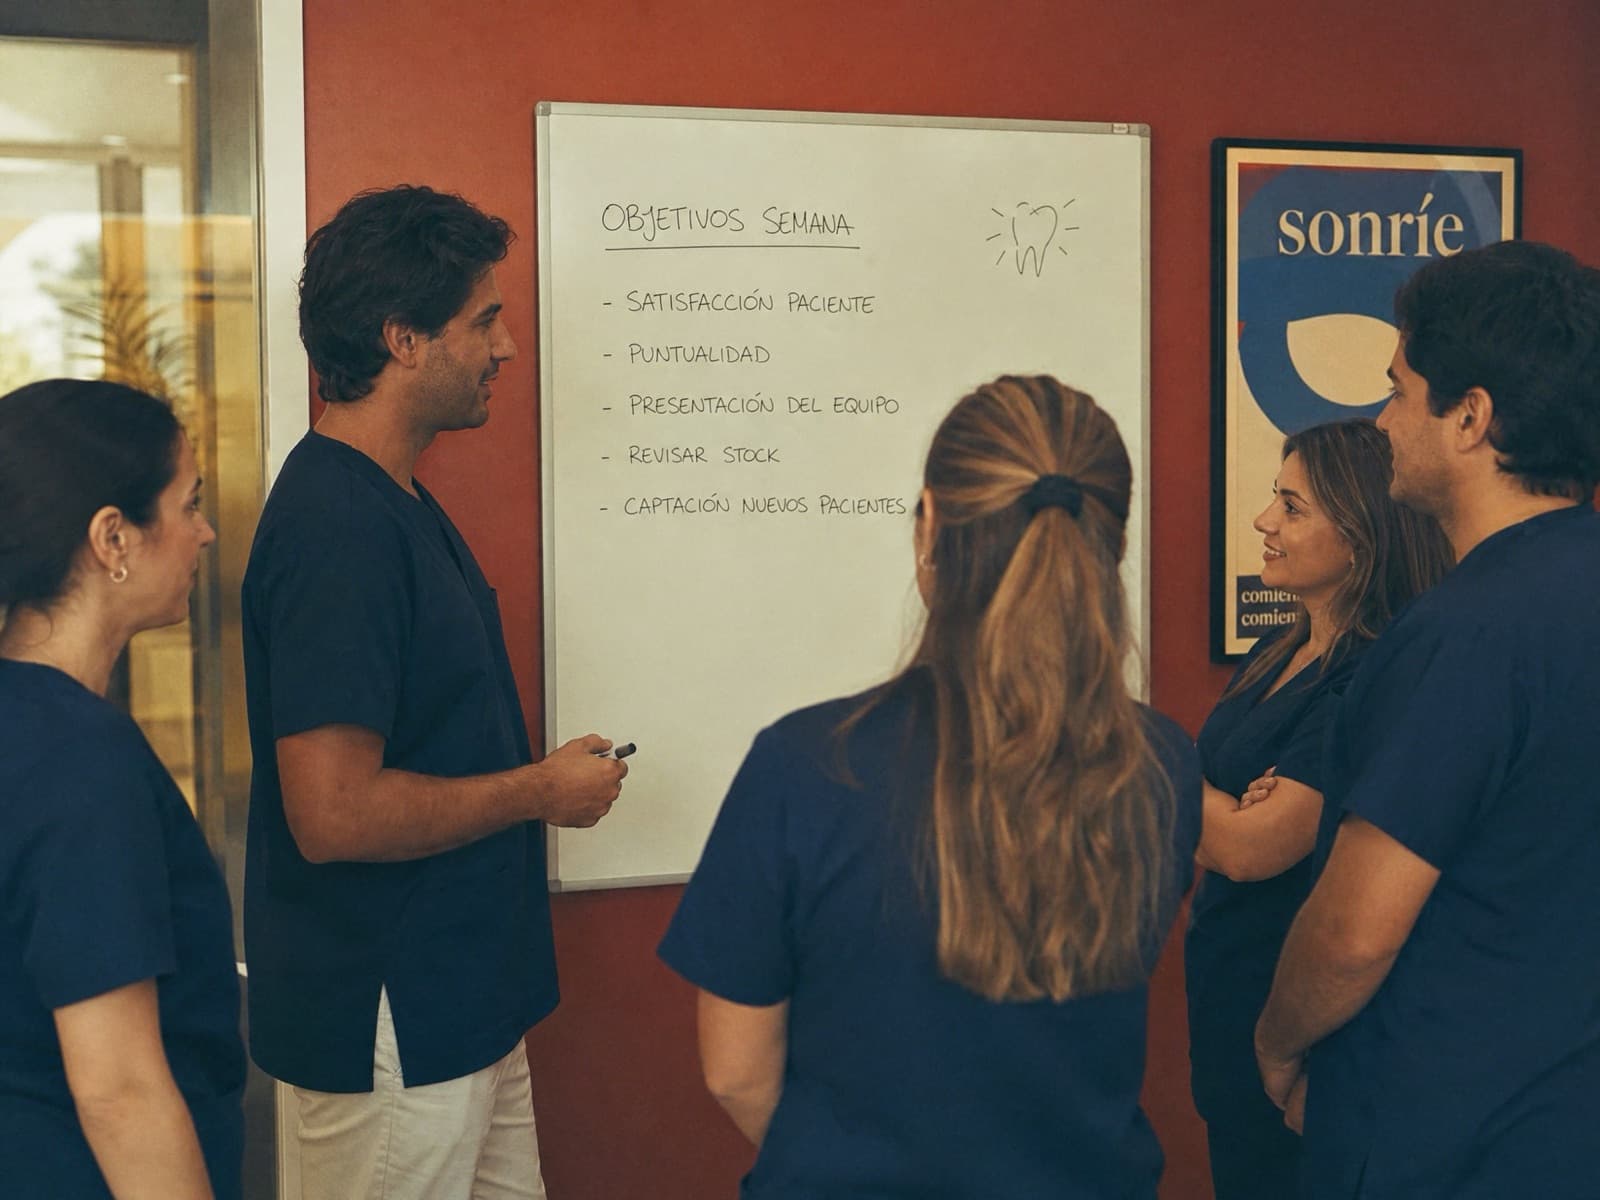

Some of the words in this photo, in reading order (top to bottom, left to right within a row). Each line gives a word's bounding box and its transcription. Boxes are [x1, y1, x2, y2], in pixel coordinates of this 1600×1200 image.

[601, 203, 745, 242] OBJETIVOS
[762, 206, 855, 236] SEMANA
[1278, 192, 1465, 258] sonríe
[626, 288, 774, 312] SATISFACCIÓN
[787, 291, 876, 314] PACIENTE
[628, 342, 771, 364] PUNTUALIDAD
[629, 391, 775, 416] PRESENTACIÓN
[787, 396, 823, 414] DEL
[833, 395, 900, 415] EQUIPO
[628, 444, 708, 465] REVISAR
[722, 446, 781, 464] STOCK
[624, 492, 730, 516] CAPTACIÓN
[742, 496, 809, 514] NUEVOS
[819, 494, 907, 515] PACIENTES
[1241, 588, 1300, 603] comien
[1241, 608, 1297, 626] comien
